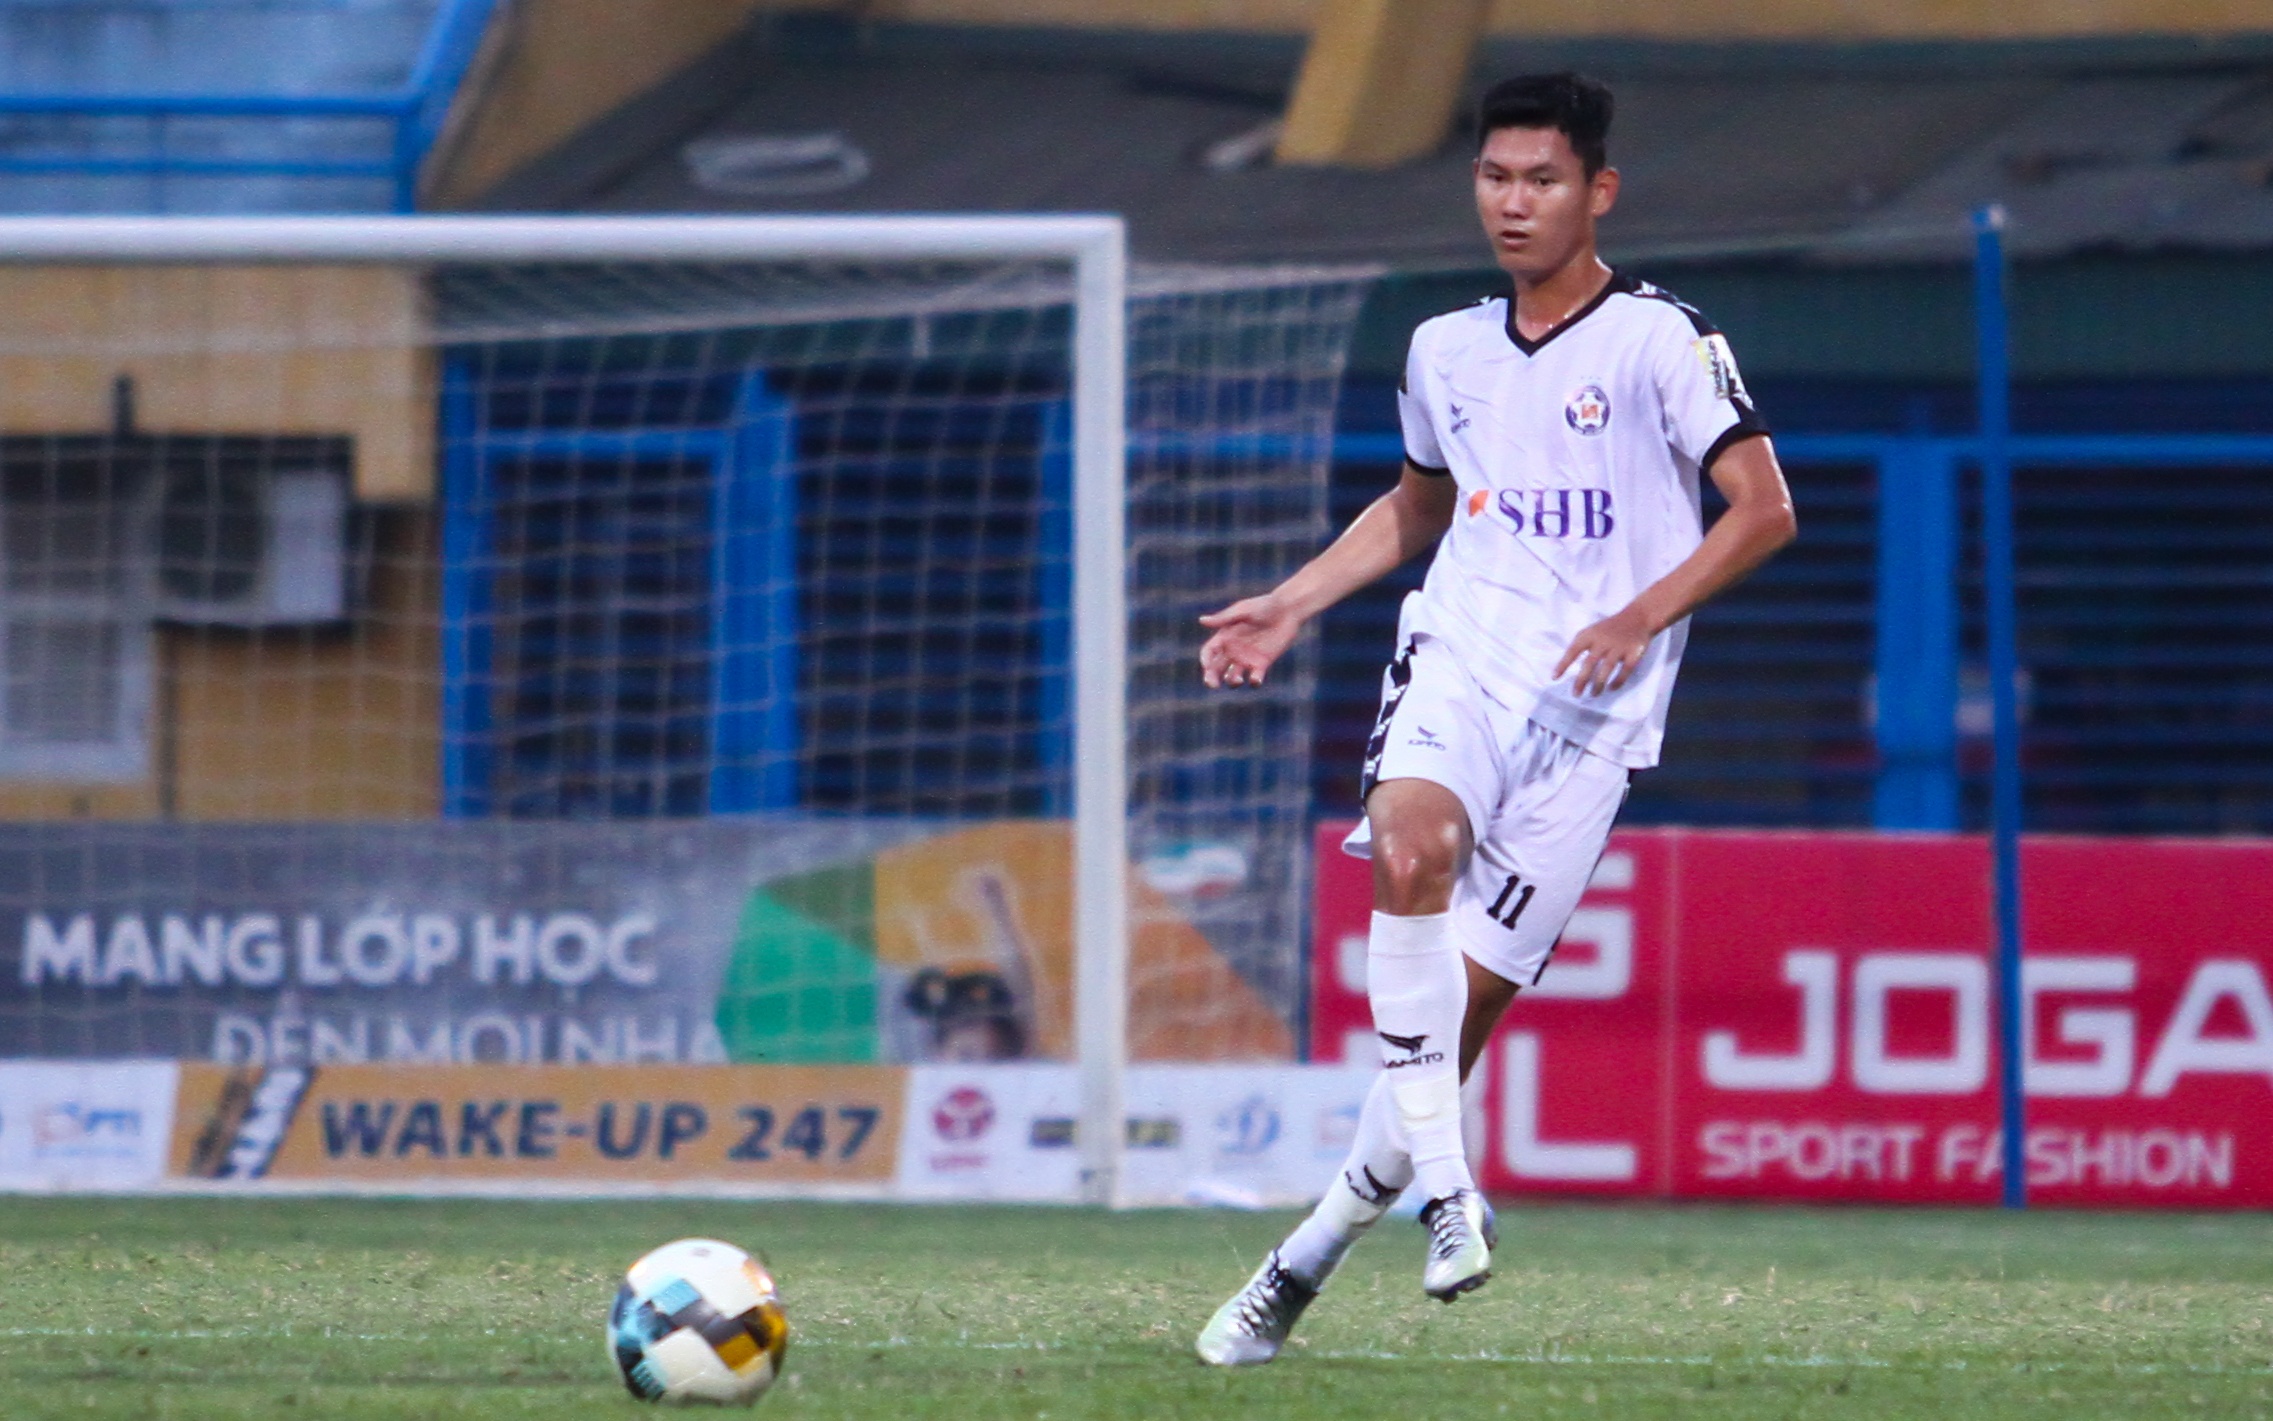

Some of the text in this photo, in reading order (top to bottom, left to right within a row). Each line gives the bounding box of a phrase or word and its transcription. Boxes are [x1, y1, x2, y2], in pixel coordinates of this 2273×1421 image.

[1498, 488, 1615, 540] SHB
[1486, 873, 1537, 931] 11
[20, 911, 285, 985] MANG
[1704, 950, 2273, 1098] JOGA
[318, 1100, 882, 1162] WAKE-UP 247
[1702, 1120, 1922, 1184] SPORT
